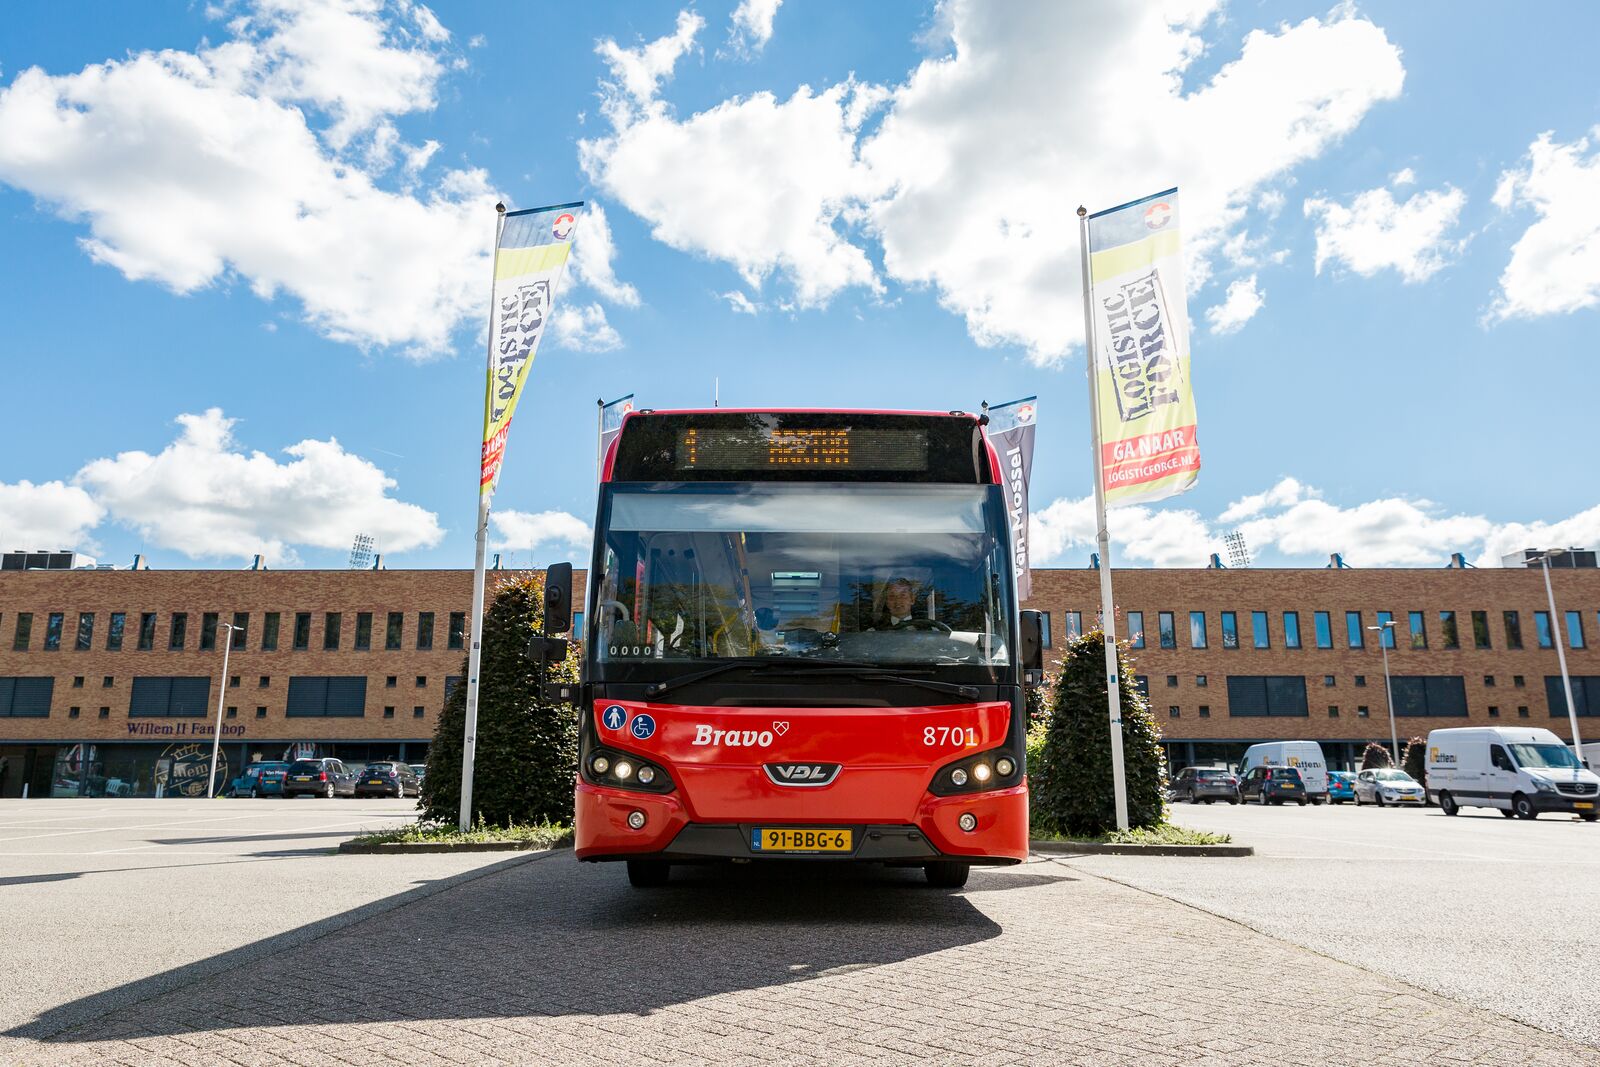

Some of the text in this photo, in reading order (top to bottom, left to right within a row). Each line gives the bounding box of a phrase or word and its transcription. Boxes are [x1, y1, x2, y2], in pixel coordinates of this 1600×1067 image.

[1103, 293, 1149, 417] LOGISTIC
[1127, 279, 1180, 406] FORCE
[1113, 430, 1185, 461] GA NAAR
[1108, 454, 1195, 484] LOGISTICFORCE.NL
[1007, 446, 1024, 531] Mossel
[127, 722, 173, 735] Willem
[191, 722, 246, 737] Fanhop
[692, 724, 774, 748] Bravo
[923, 726, 978, 747] 8701
[776, 766, 827, 780] VDL
[769, 831, 845, 848] 91-BBG-6
